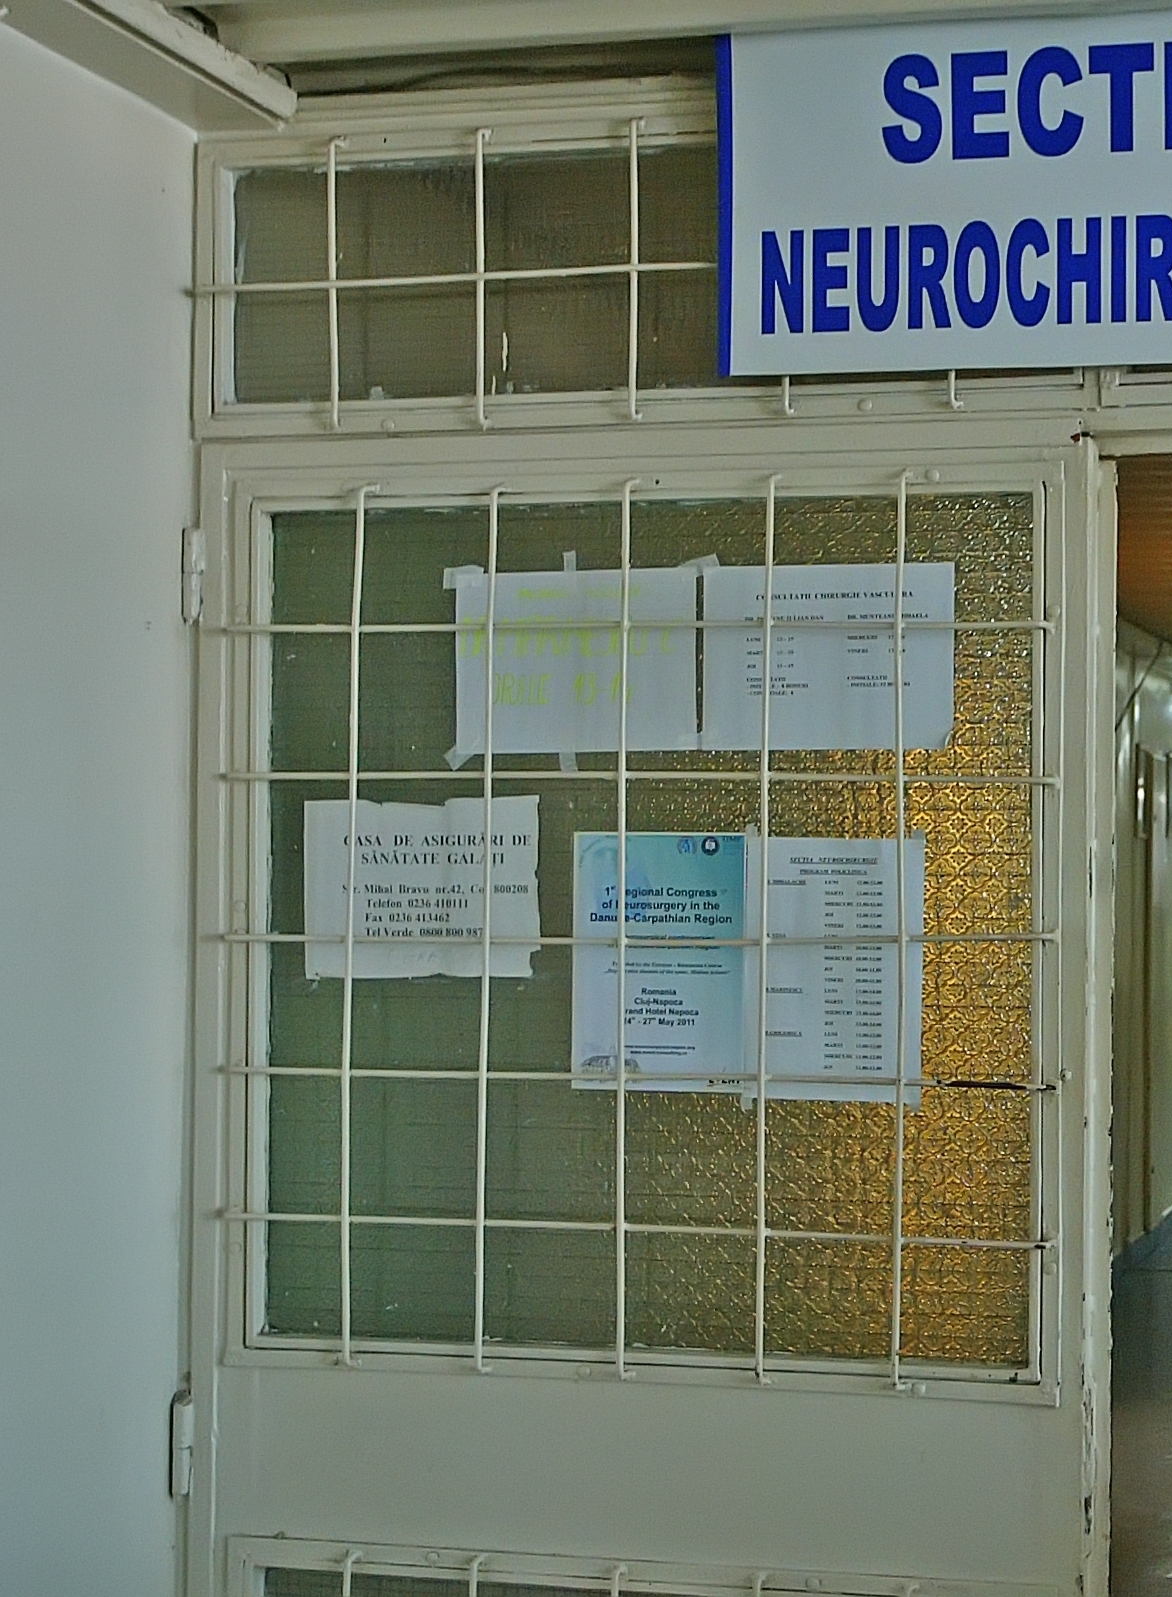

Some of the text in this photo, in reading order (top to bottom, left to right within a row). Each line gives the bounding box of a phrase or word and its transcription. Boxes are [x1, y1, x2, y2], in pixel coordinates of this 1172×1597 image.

[394, 834, 414, 847] DE
[512, 833, 531, 847] DE
[470, 885, 486, 894] Co
[493, 884, 529, 894] 800208
[624, 886, 664, 899] egional
[666, 887, 718, 899] Congress
[367, 898, 402, 908] Telefon
[407, 899, 431, 908] 0236
[602, 899, 613, 909] of
[690, 900, 701, 910] in
[703, 900, 720, 911] the
[365, 913, 450, 922] Fax 0236 413462
[589, 912, 733, 926] Danue-Carpathian Region
[365, 927, 380, 937] Tel
[383, 927, 414, 937] Verde
[419, 928, 443, 937] 0800
[446, 928, 463, 937] 800
[641, 987, 677, 996] Romania
[634, 997, 683, 1007] Cluj-Napoca
[624, 1007, 699, 1018] rand Hotel Napoca
[658, 1017, 675, 1027] May
[677, 1018, 696, 1026] 2011
